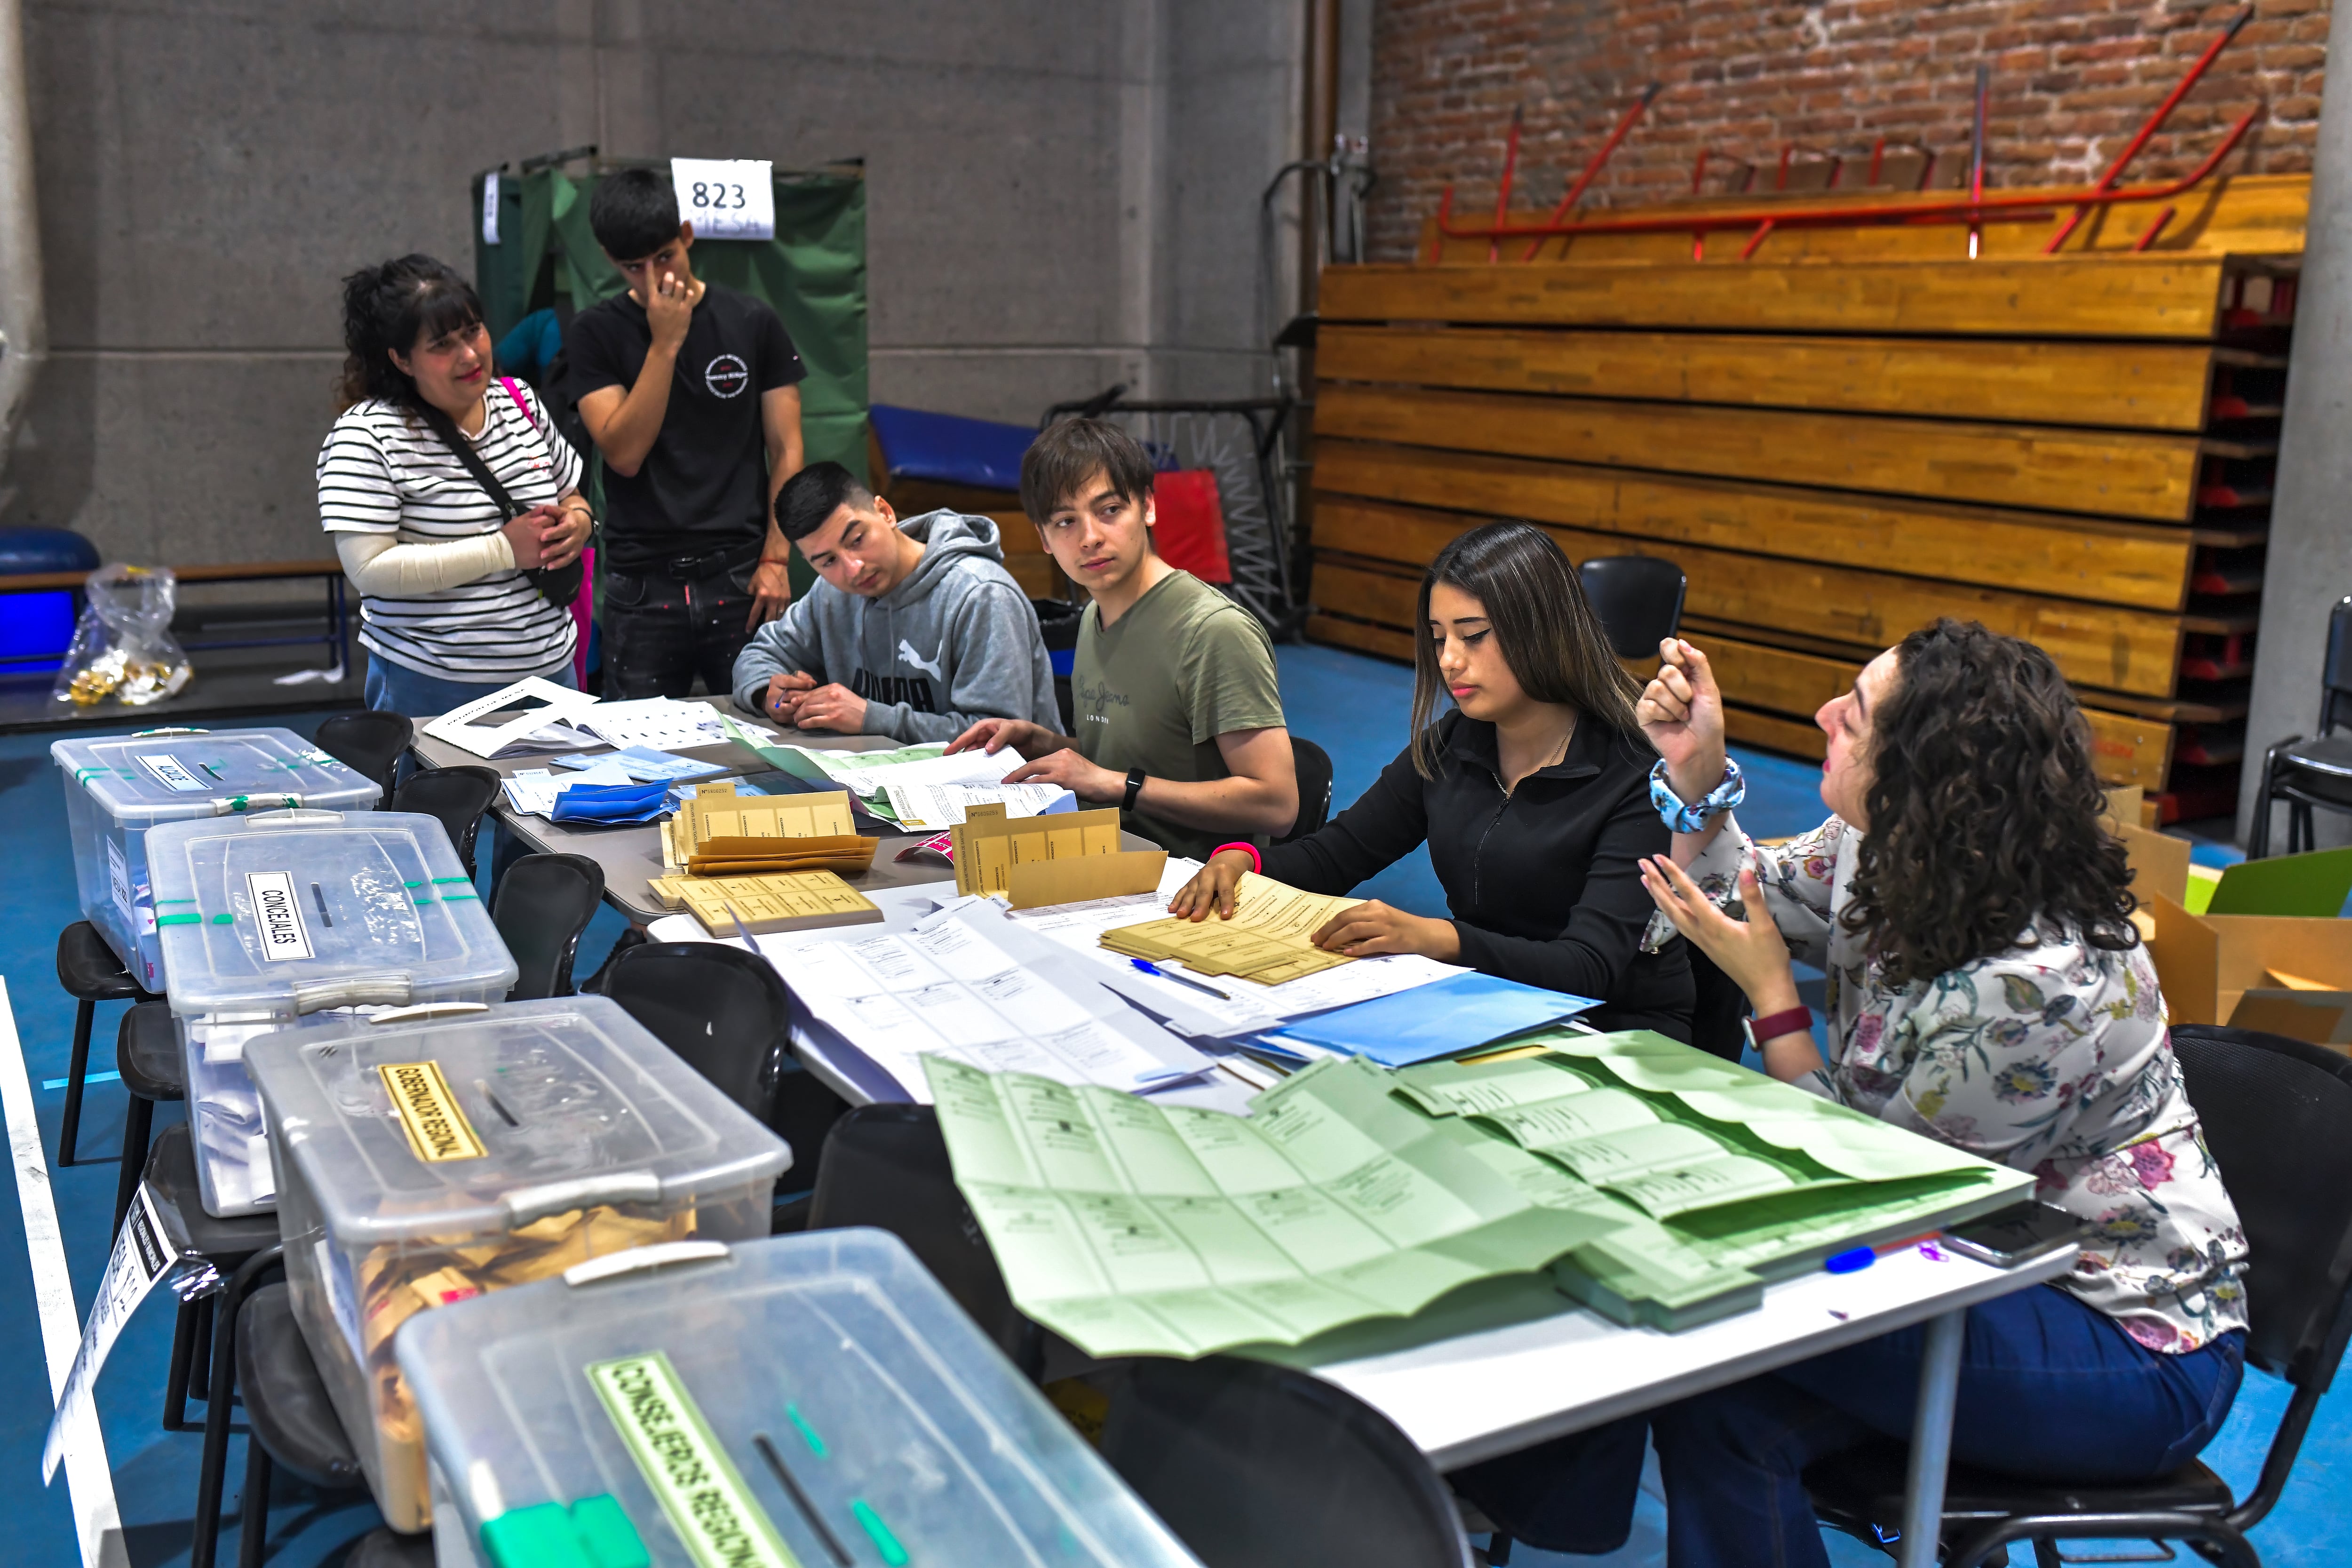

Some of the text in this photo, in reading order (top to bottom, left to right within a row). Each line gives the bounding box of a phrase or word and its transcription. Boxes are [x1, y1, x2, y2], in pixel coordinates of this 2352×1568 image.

[692, 181, 746, 209] 823
[262, 890, 297, 944] CONCEJALES
[395, 1068, 461, 1157] GOBERNADOR REGIONAL
[612, 1361, 767, 1568] CONSEJEROS REGION
